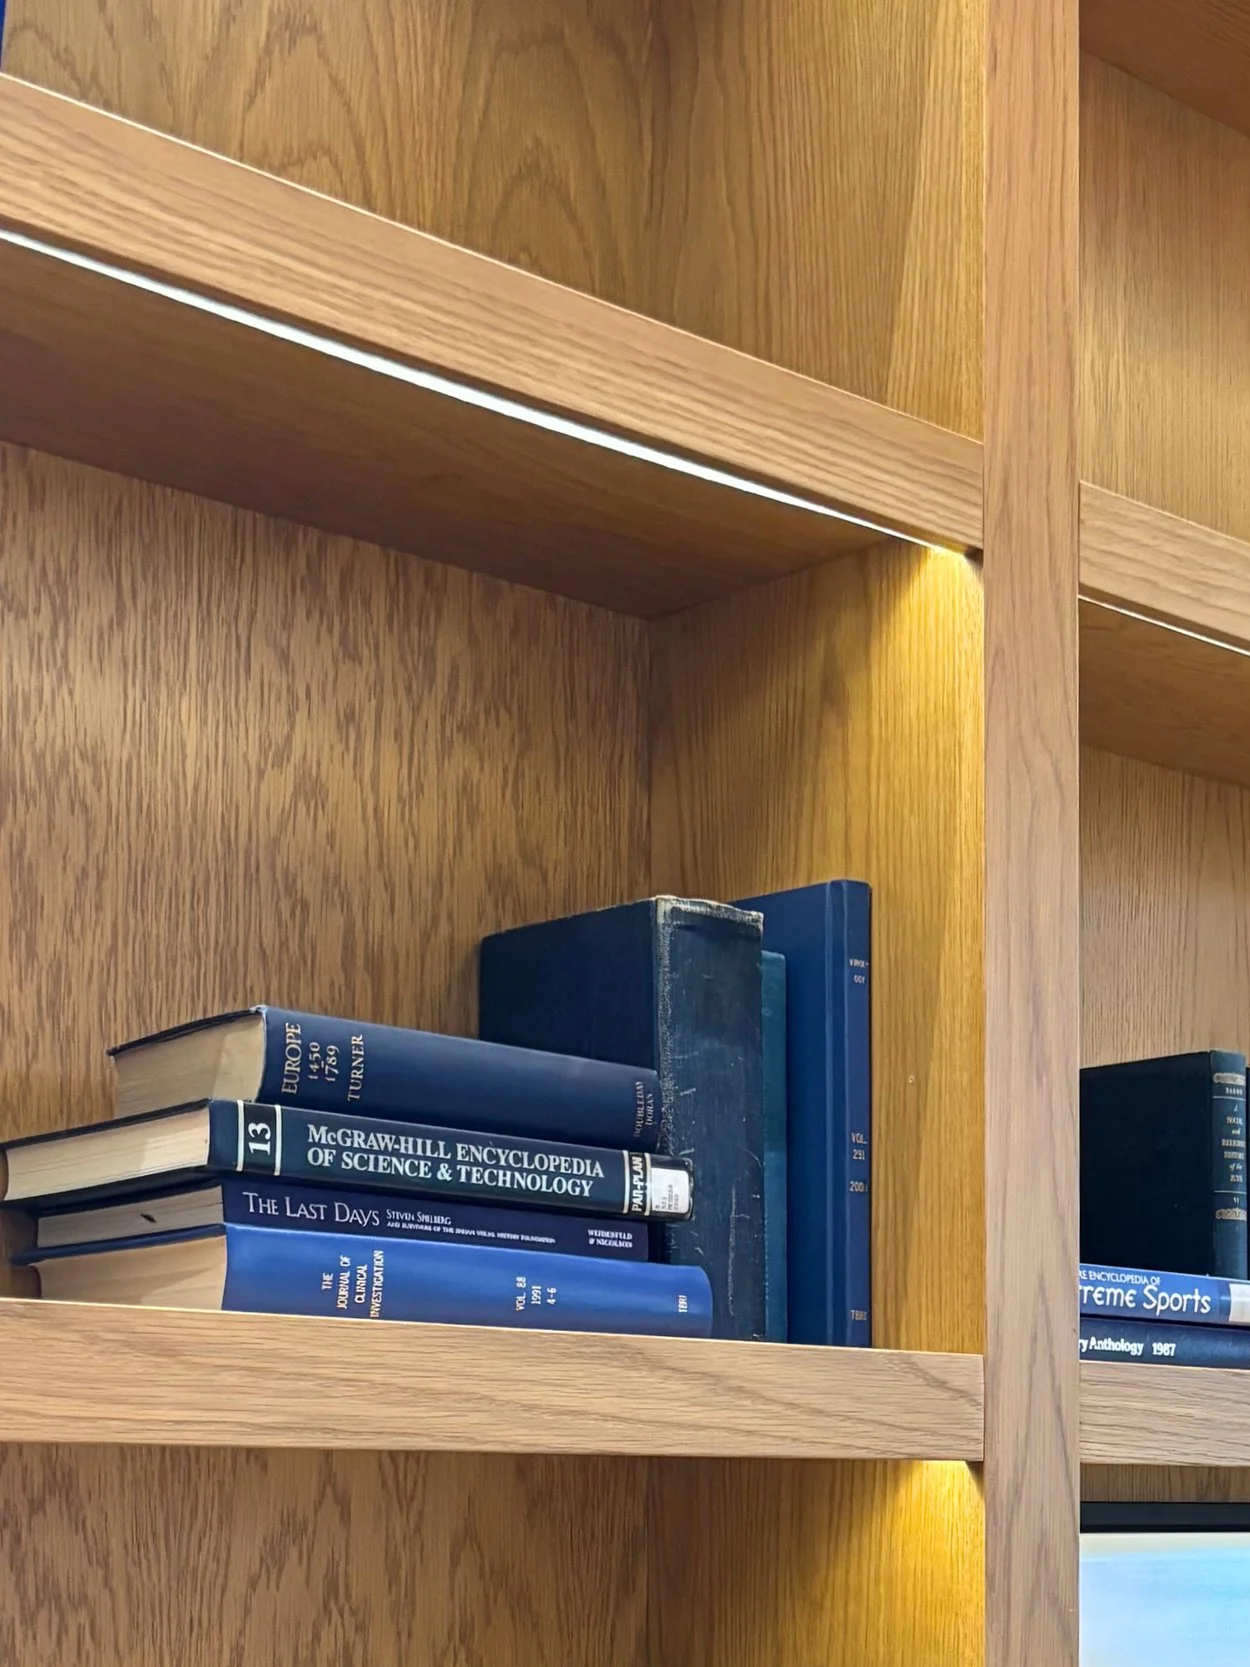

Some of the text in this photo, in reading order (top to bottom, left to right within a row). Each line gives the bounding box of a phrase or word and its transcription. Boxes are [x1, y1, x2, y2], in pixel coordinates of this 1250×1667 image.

[281, 1022, 302, 1095] EUROPE
[308, 1041, 321, 1080] 1450
[325, 1045, 339, 1082] 1789
[348, 1034, 363, 1102] TURNER
[248, 1122, 271, 1155] 13
[307, 1124, 604, 1178] McGRAW-HILL ENCYCLOPEDIA
[308, 1147, 594, 1197] OF SCIENCE & TECHNOLOGY
[322, 1272, 333, 1290] THE
[336, 1255, 351, 1309] JOURNAL OF
[354, 1264, 367, 1303] CLINICAL
[370, 1250, 384, 1318] INVESTIGATION
[531, 1286, 542, 1305] 1991
[1089, 1270, 1161, 1286] ENCYCLOPEDIA OF
[1142, 1284, 1211, 1316] Sports
[1089, 1336, 1177, 1356] Anthology 1987
